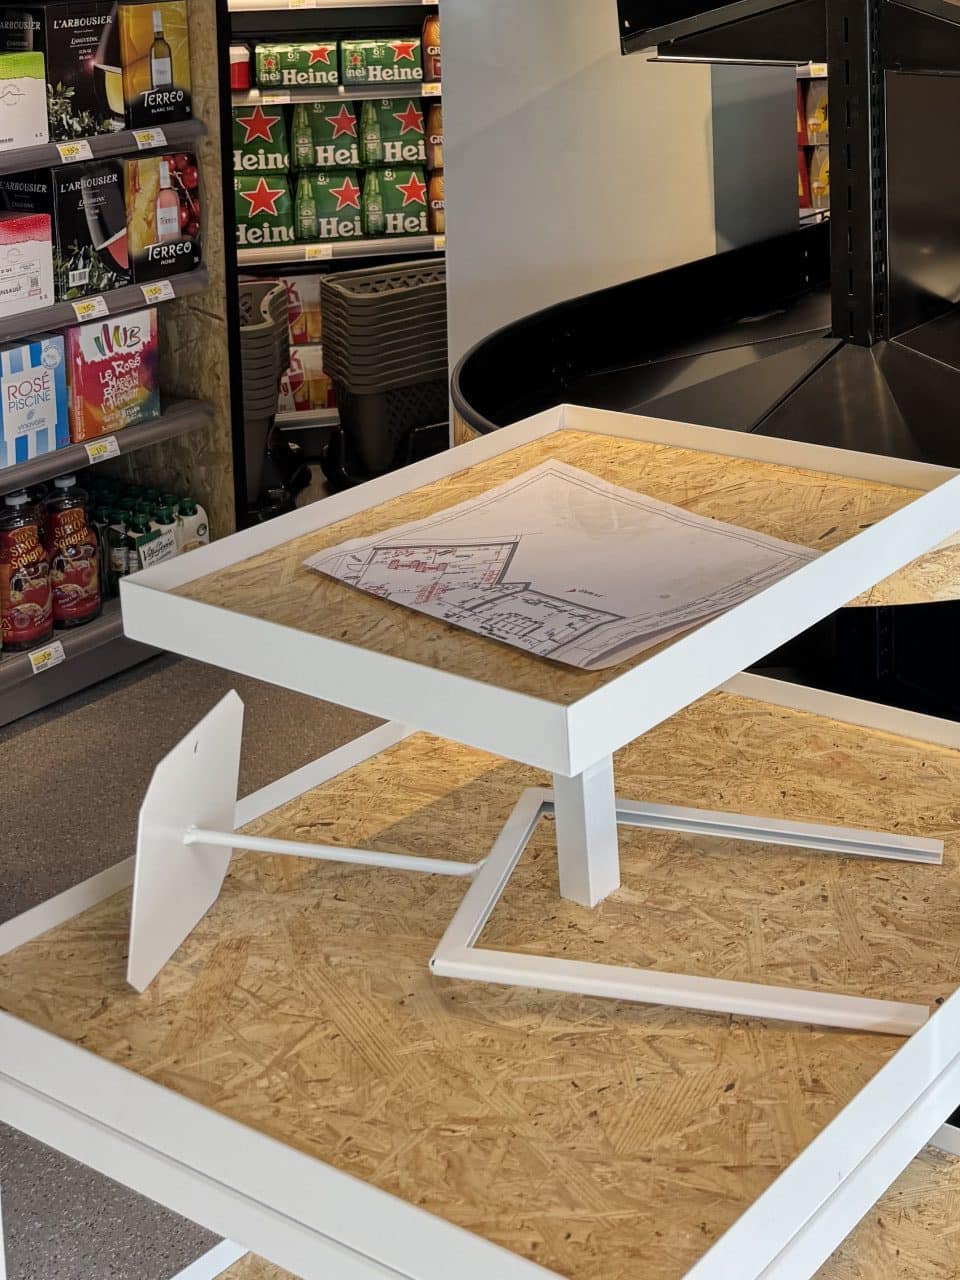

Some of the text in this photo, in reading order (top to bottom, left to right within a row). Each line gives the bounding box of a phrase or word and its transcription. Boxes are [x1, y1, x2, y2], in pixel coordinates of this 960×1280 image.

[53, 16, 112, 29] L'ARBOUSIER
[140, 88, 184, 108] TERREO
[144, 241, 192, 261] TERREO
[7, 371, 50, 401] ROSÉ
